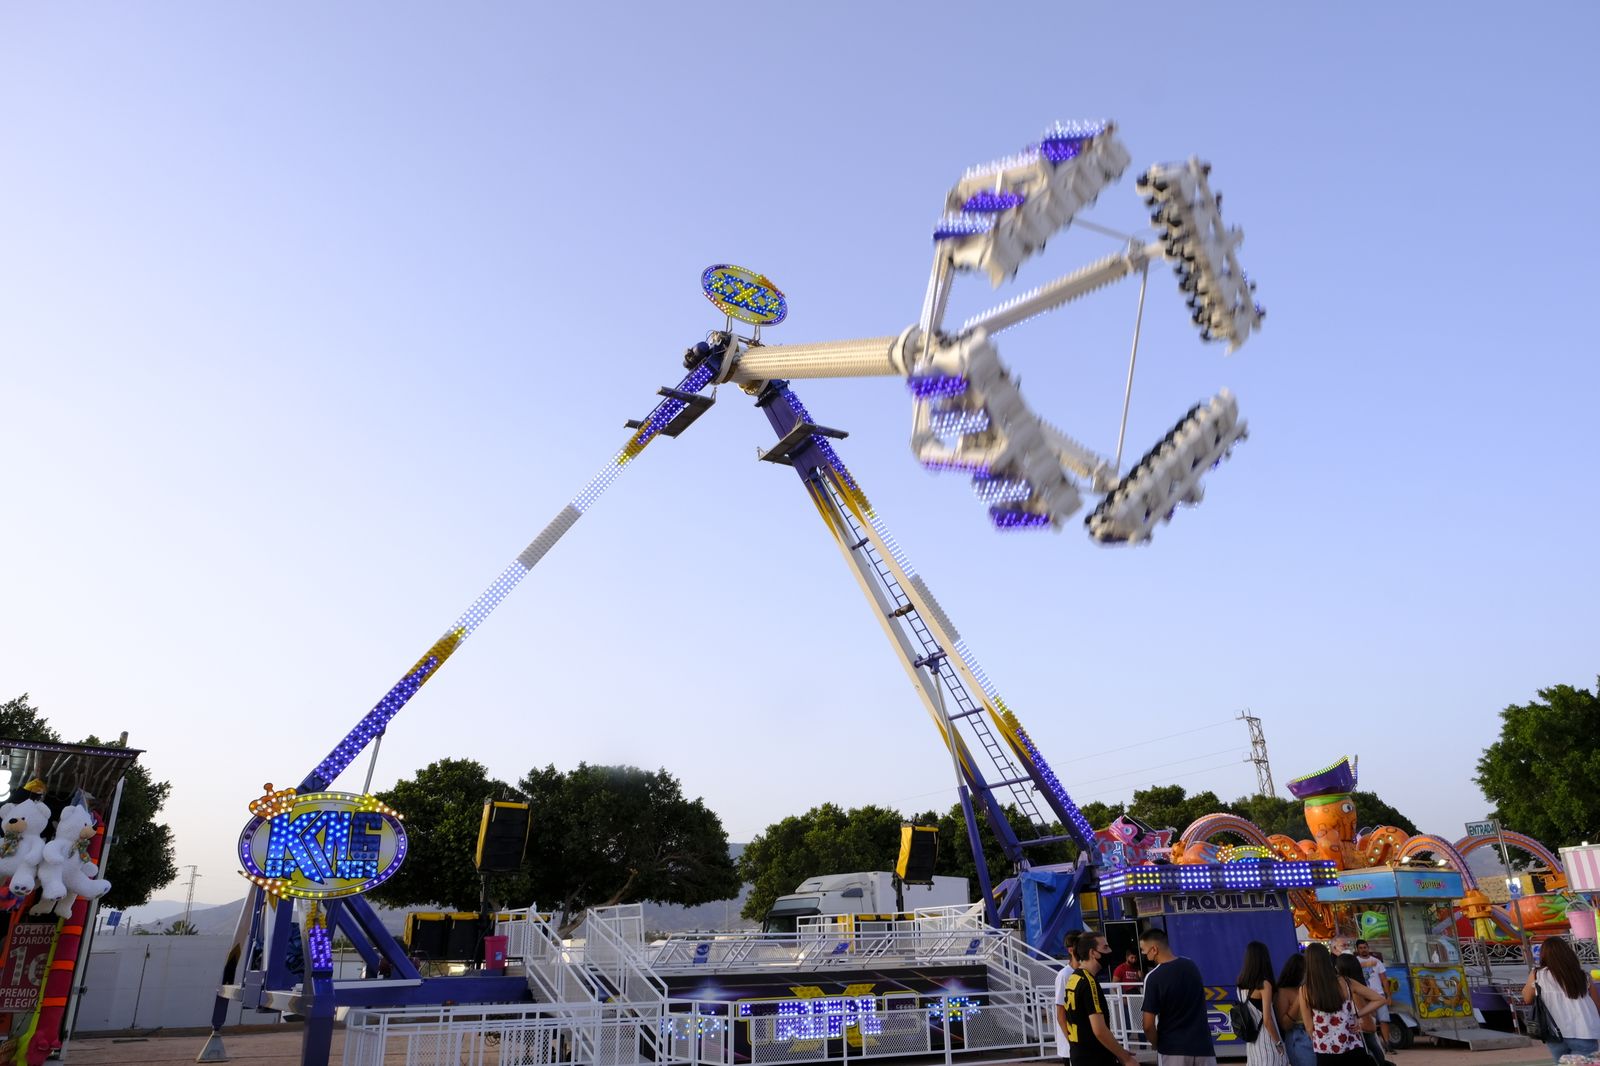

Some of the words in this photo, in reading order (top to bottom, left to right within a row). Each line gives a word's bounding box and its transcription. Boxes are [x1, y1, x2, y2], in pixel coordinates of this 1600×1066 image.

[1172, 893, 1280, 911] TAQUILLA
[15, 924, 56, 935] OFERTA
[11, 936, 17, 945] 3
[0, 988, 38, 998] PREMIO
